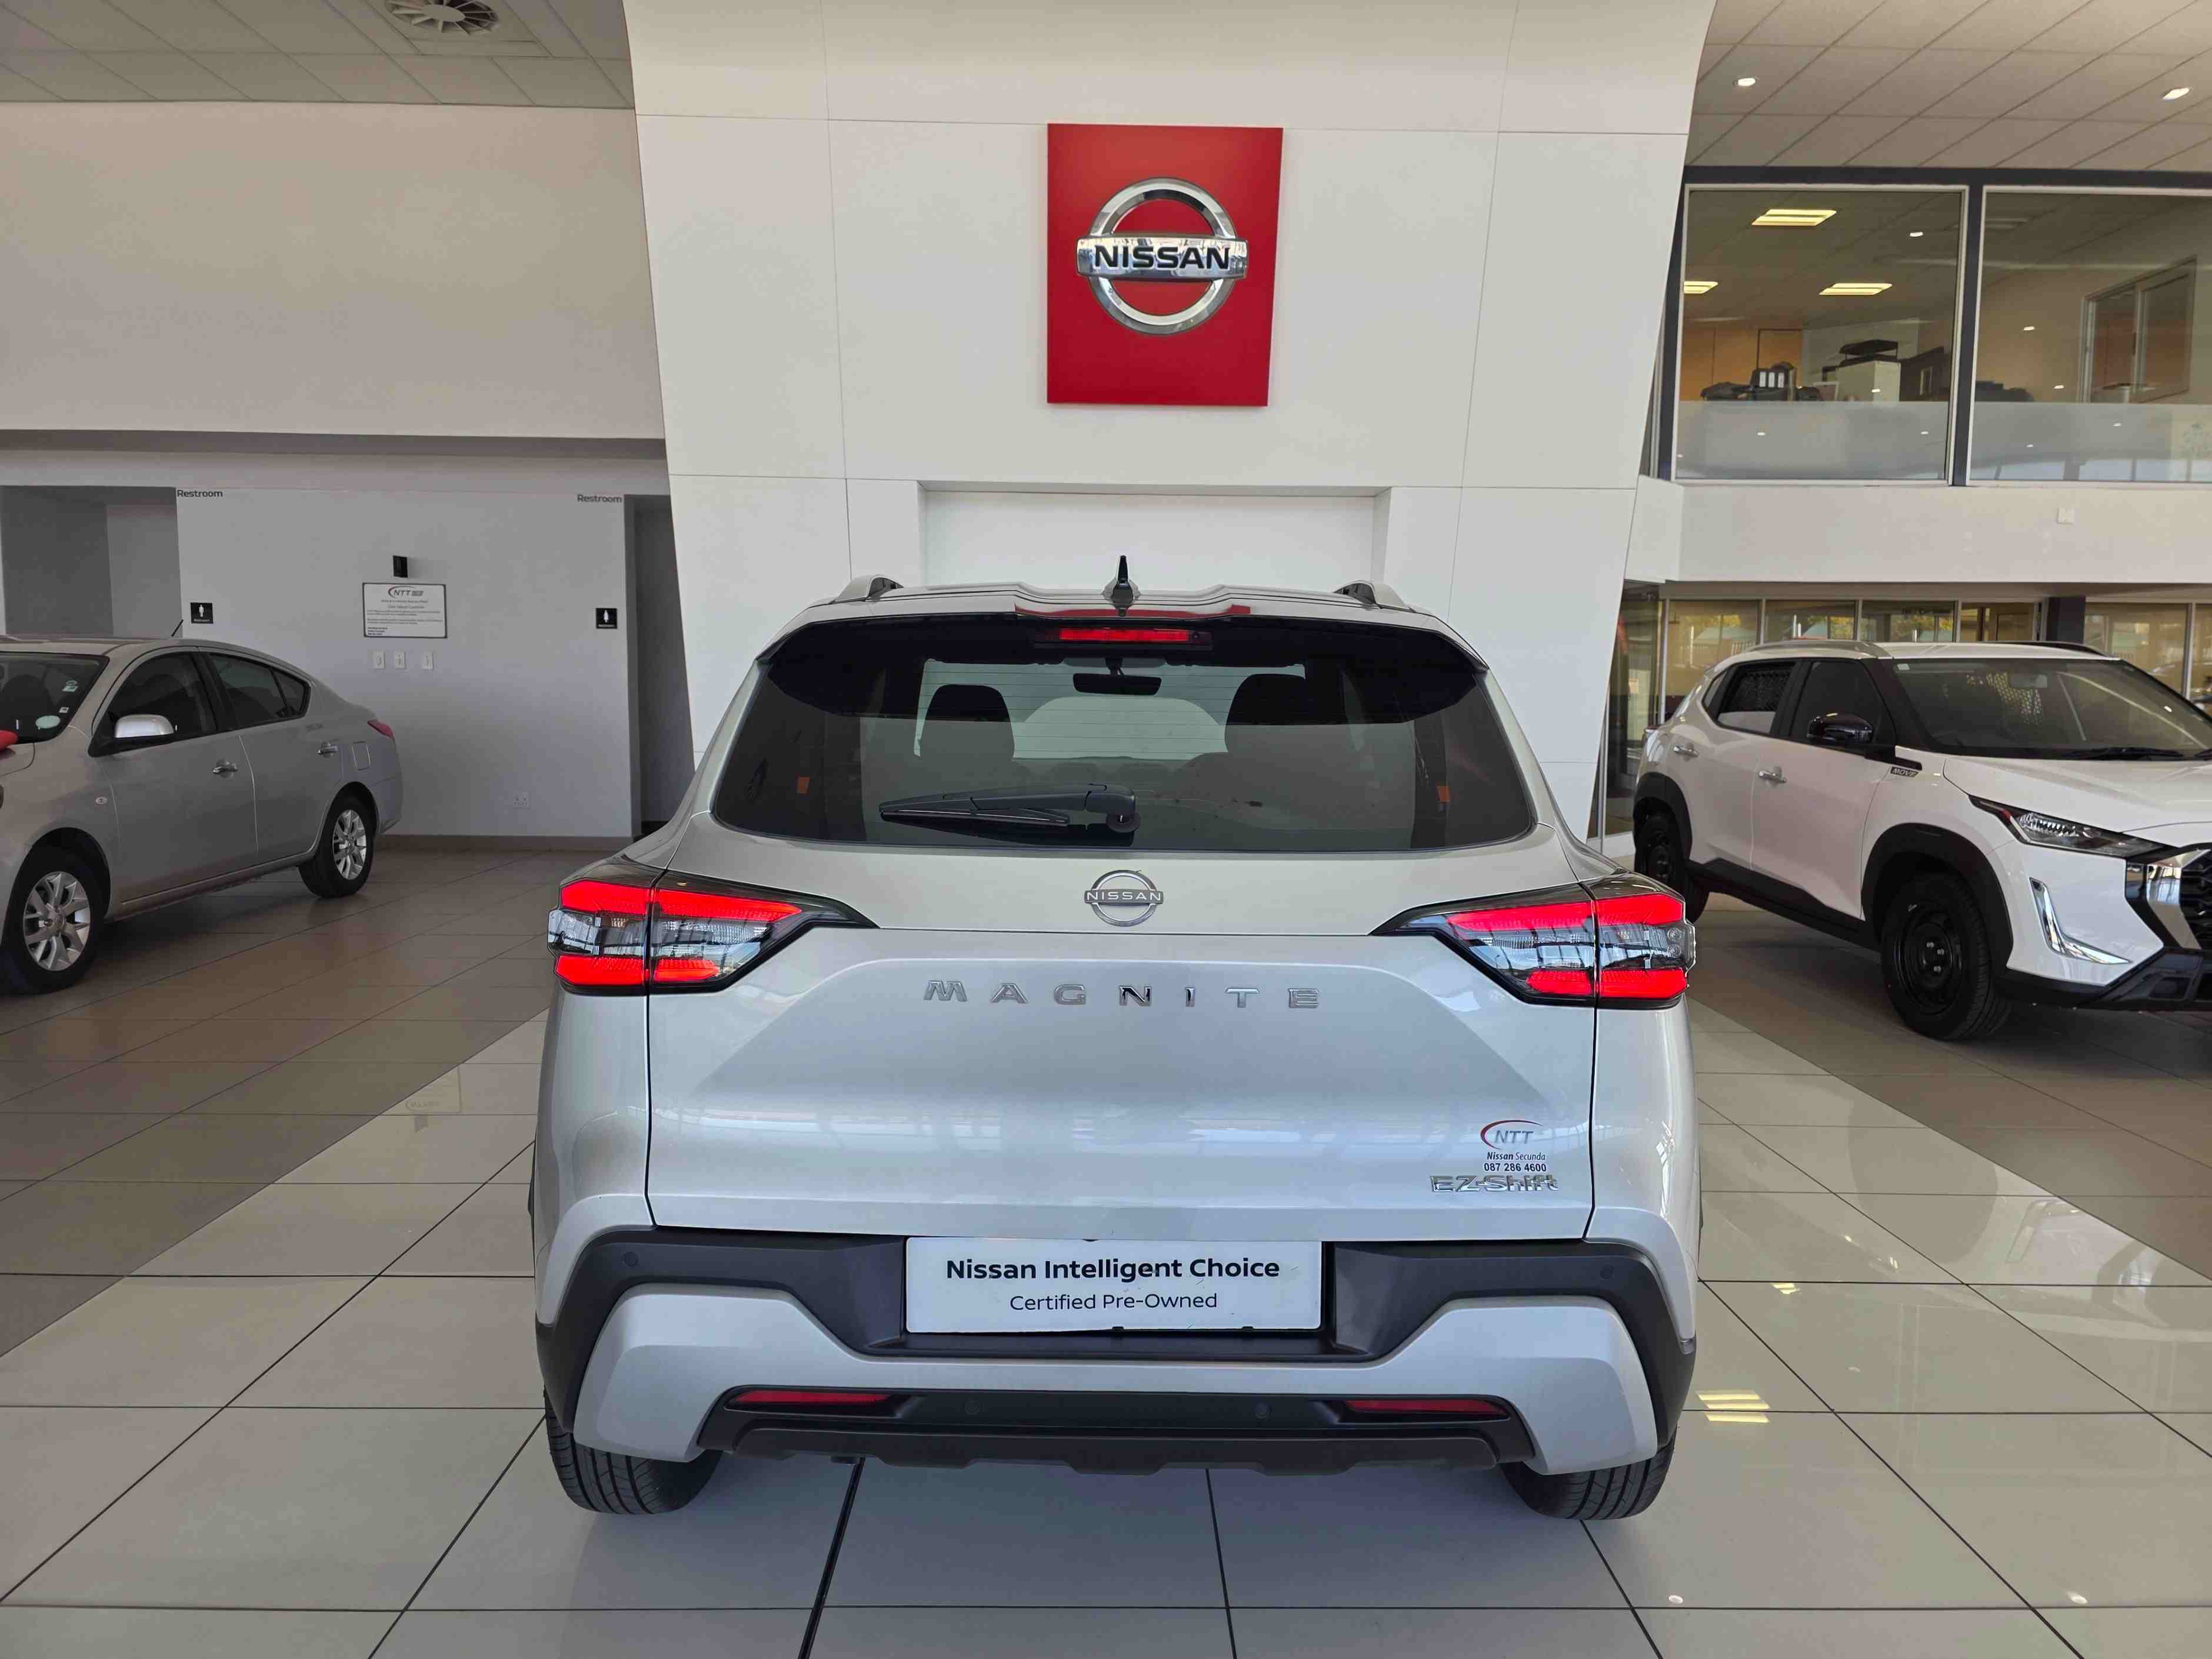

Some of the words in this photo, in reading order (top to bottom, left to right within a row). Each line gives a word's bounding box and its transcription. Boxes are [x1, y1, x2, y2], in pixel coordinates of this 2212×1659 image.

[1095, 245, 1230, 269] NISSAN
[577, 494, 622, 502] Restroom
[1087, 891, 1161, 901] NISSAN
[923, 979, 1320, 1008] MAGNITE
[1494, 1130, 1534, 1144] NTT
[1487, 1151, 1514, 1160] Nissan
[1515, 1152, 1546, 1161] Secunda
[1484, 1162, 1500, 1171] 087
[1504, 1163, 1521, 1172] 286
[1524, 1163, 1547, 1172] 4600
[1430, 1174, 1558, 1192] EZ-Shift
[946, 1258, 1037, 1280] Nissan
[1045, 1257, 1182, 1282] Intelligent
[1190, 1257, 1281, 1278] Choice
[1010, 1293, 1097, 1311] Certified
[1102, 1292, 1218, 1310] Pre-Owned
